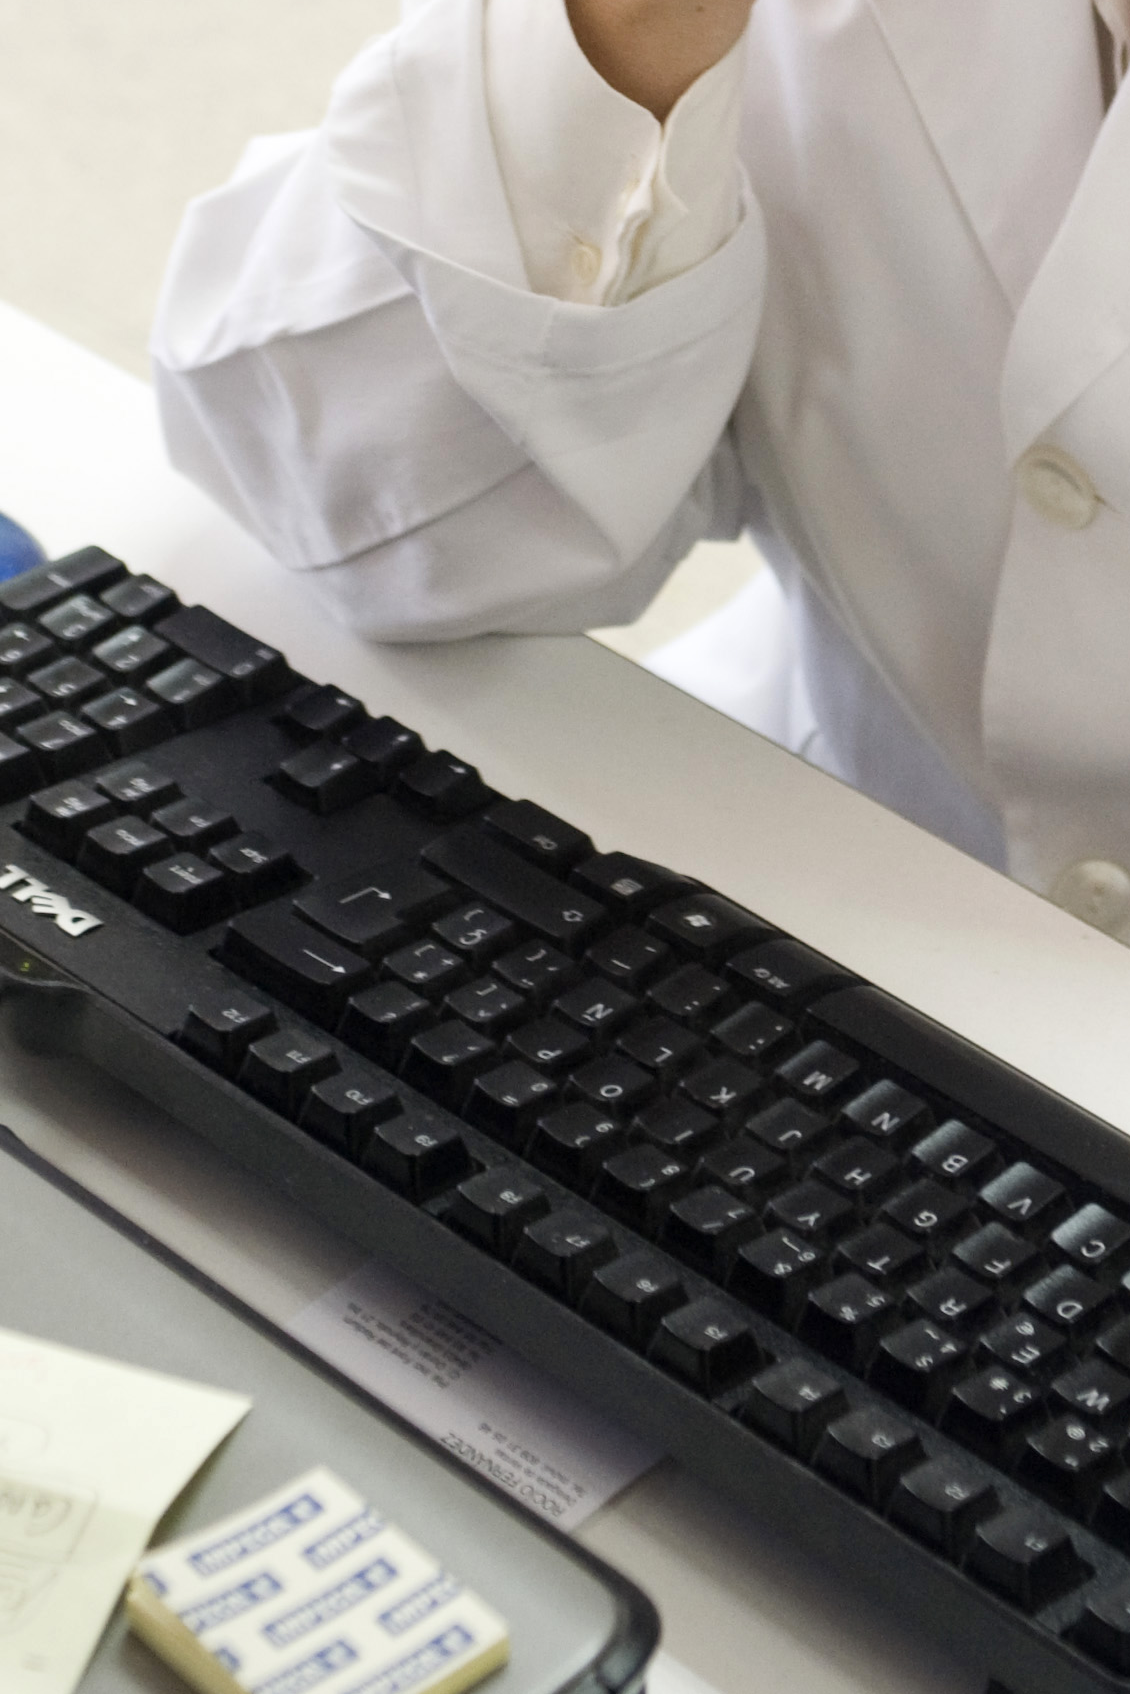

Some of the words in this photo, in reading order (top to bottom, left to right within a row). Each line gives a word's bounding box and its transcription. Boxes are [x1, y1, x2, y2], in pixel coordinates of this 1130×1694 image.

[115, 655, 140, 670] 2
[53, 683, 77, 697] 5
[222, 1008, 250, 1024] F12
[581, 1003, 614, 1023] Ñ
[286, 1050, 313, 1064] F11
[537, 1048, 563, 1061] P
[655, 1046, 673, 1063] L
[803, 1070, 834, 1091] M
[346, 1089, 374, 1106] F10
[709, 1086, 738, 1104] K
[596, 1122, 614, 1133] 9
[871, 1111, 901, 1132] N
[414, 1134, 439, 1148] F9
[778, 1129, 803, 1143] J
[661, 1164, 681, 1176] 8
[941, 1154, 969, 1174] B
[728, 1166, 756, 1183] U
[844, 1167, 873, 1186] H
[499, 1190, 524, 1204] F8
[1006, 1197, 1033, 1216] V
[797, 1211, 822, 1227] Y
[913, 1210, 939, 1228] G
[565, 1235, 591, 1248] F7
[1080, 1239, 1107, 1258] C
[866, 1256, 891, 1275] T
[983, 1258, 1012, 1276] F
[636, 1279, 660, 1293] F6
[939, 1298, 967, 1317] R
[1055, 1300, 1084, 1321] D
[1011, 1345, 1041, 1365] E
[1076, 1389, 1111, 1411] W
